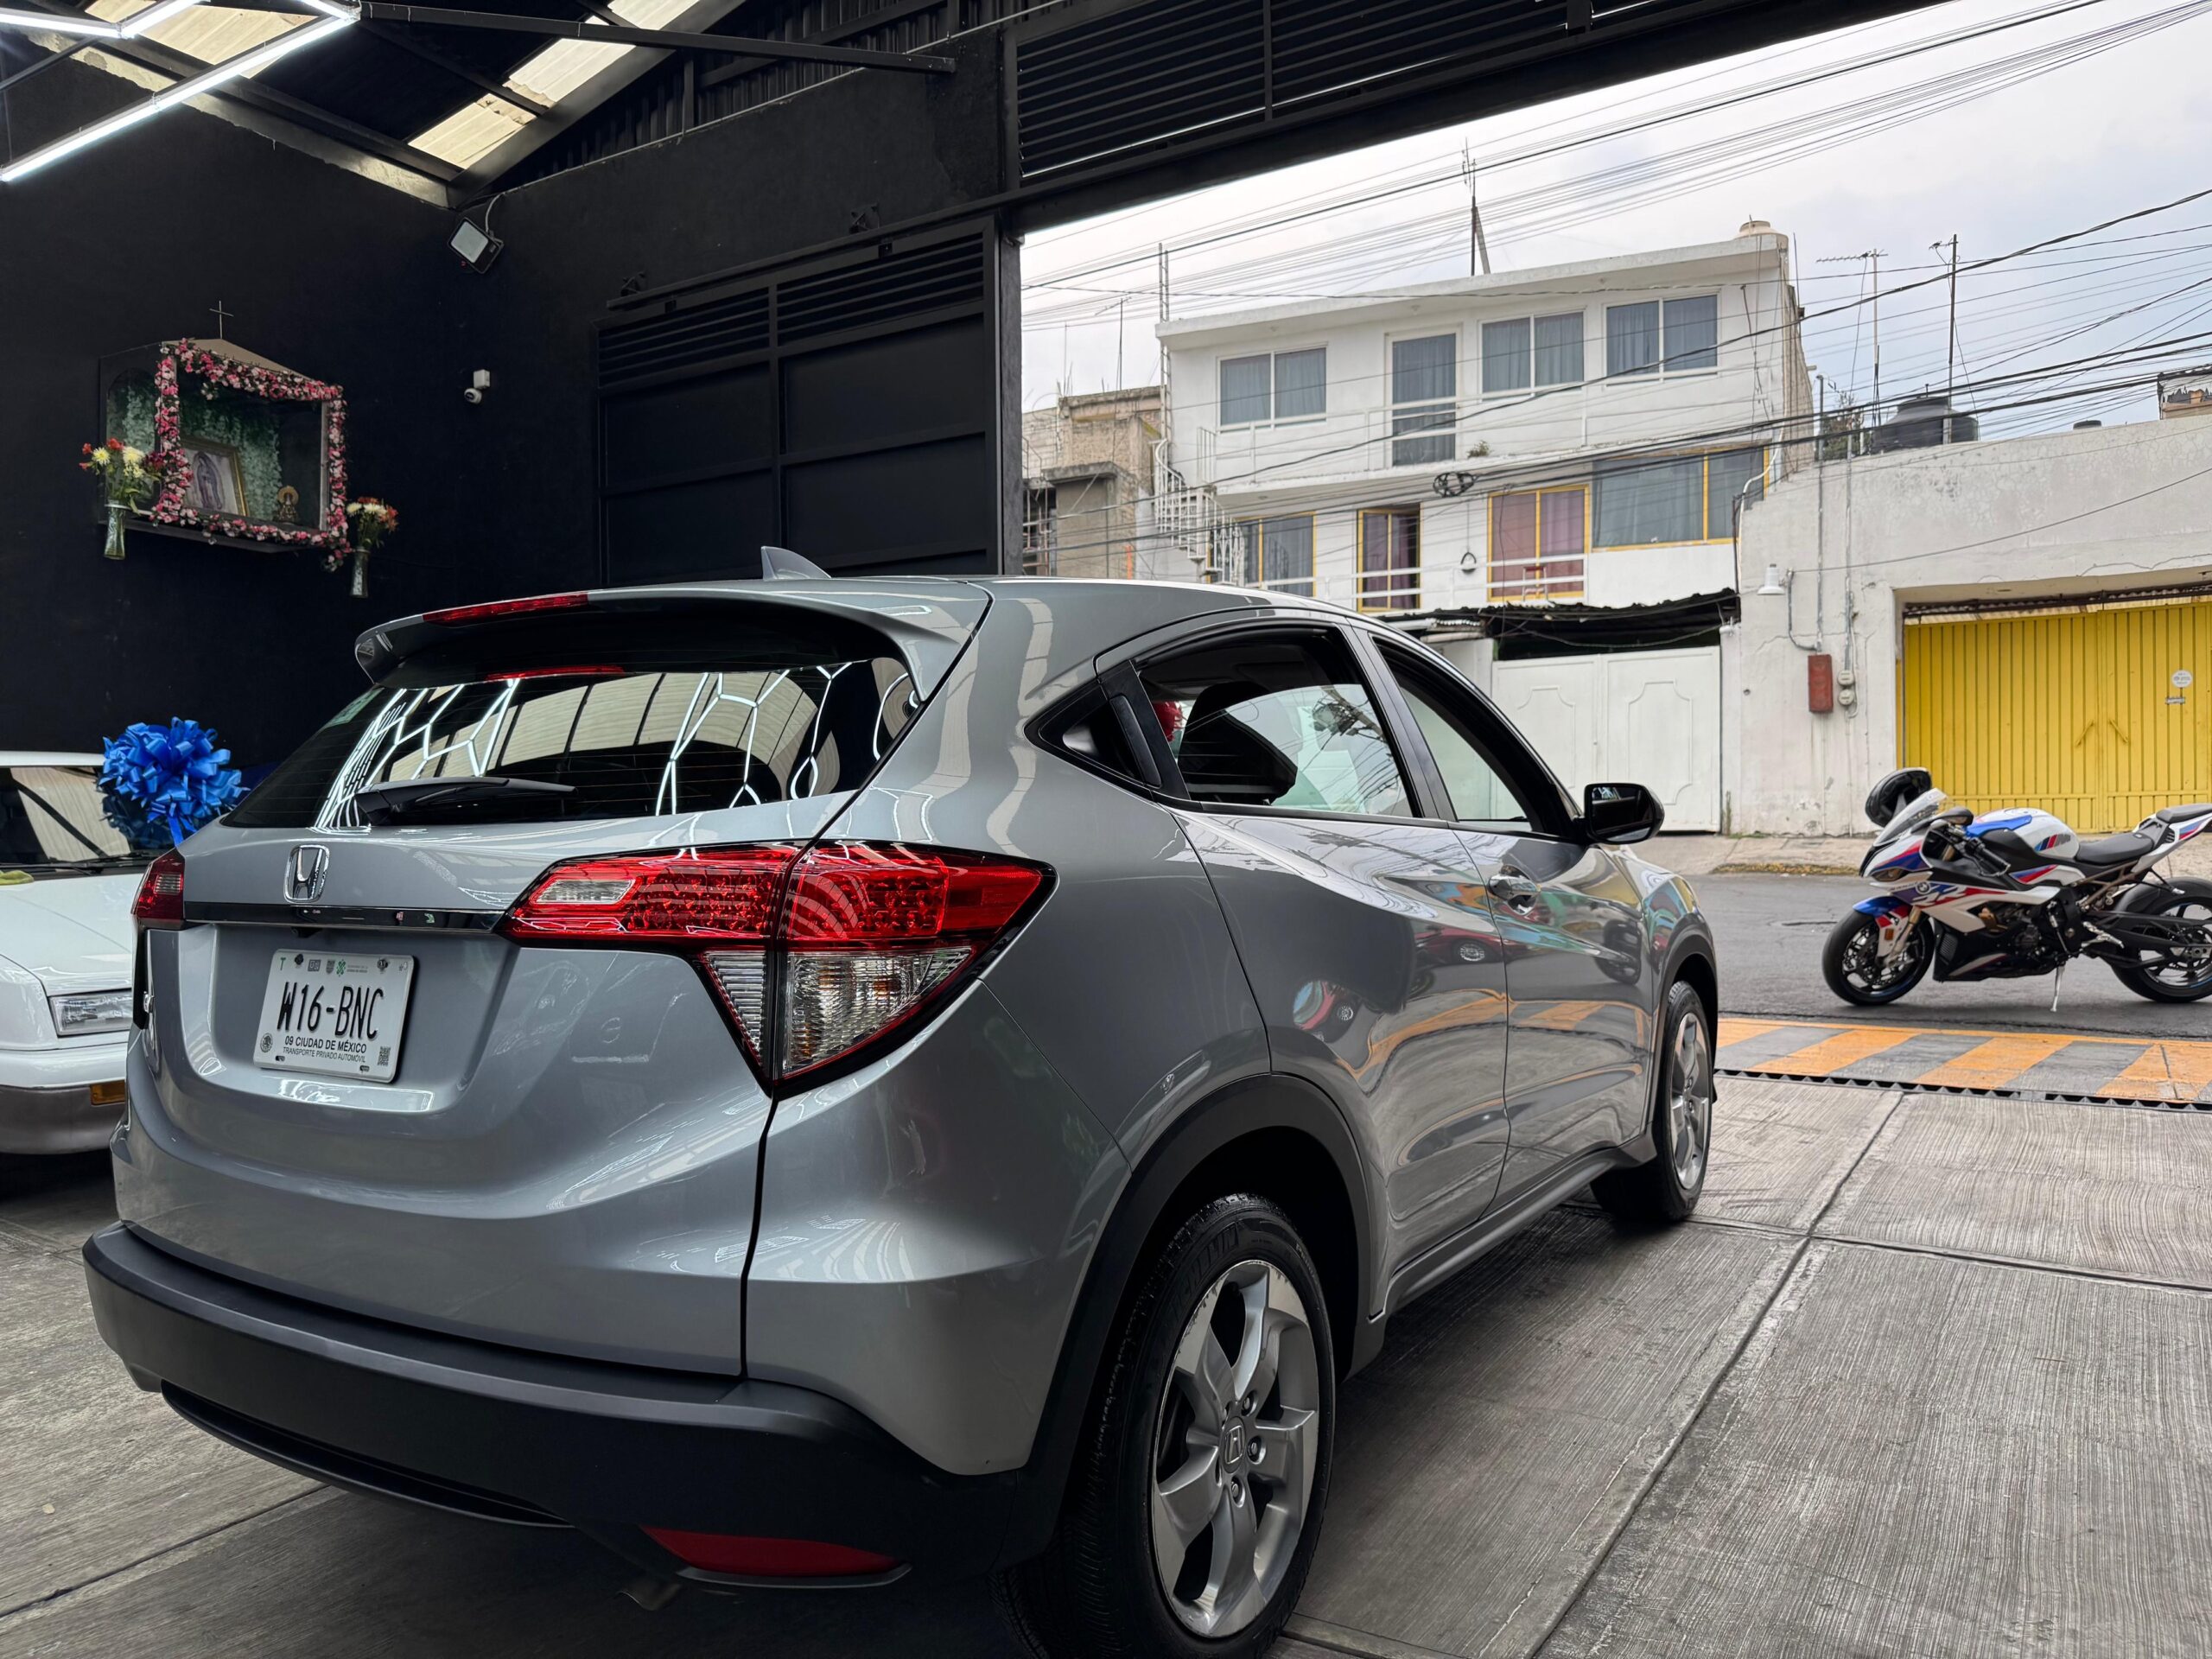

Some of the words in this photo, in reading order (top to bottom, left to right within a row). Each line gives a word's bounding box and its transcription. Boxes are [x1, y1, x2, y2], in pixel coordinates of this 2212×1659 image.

[276, 982, 385, 1040] W16-BNC
[283, 1046, 315, 1058] TRANSPORTE
[315, 1050, 338, 1059] PRIVADO
[285, 1035, 294, 1046] 09
[296, 1036, 324, 1049] CIUDAD
[325, 1039, 336, 1051] DE
[337, 1039, 367, 1053] MÉXICO
